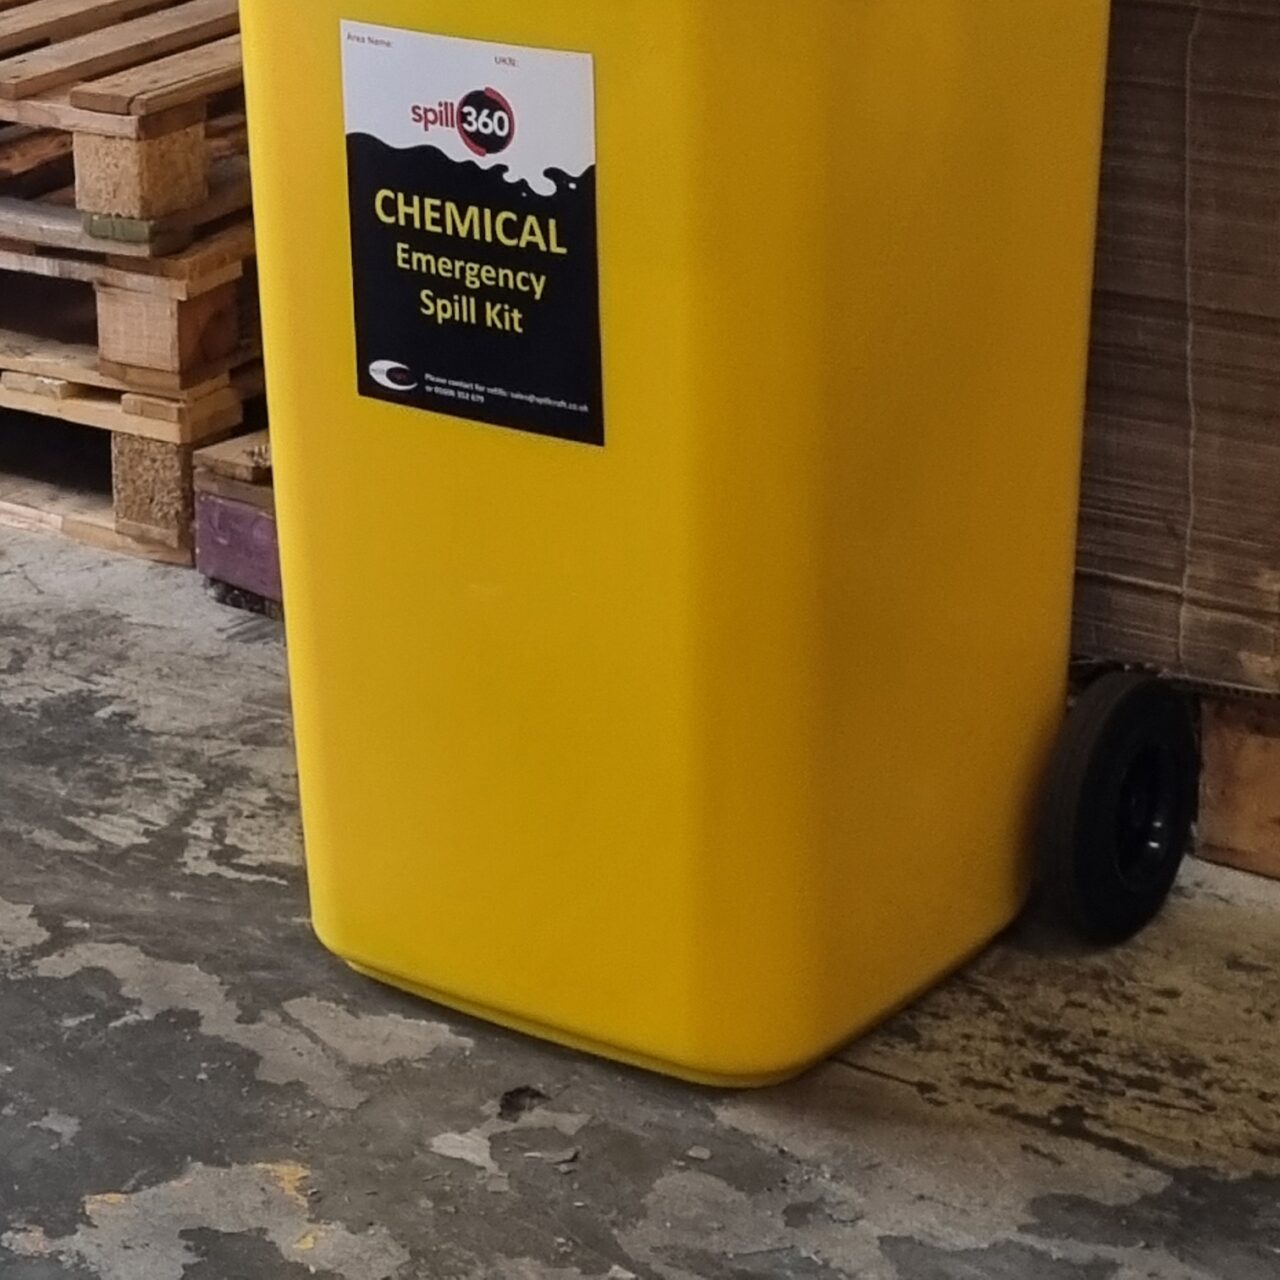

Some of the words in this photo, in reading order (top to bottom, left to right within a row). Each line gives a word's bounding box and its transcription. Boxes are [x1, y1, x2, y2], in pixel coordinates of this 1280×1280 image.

[411, 100, 455, 132] spill
[461, 105, 509, 137] 360
[374, 188, 568, 255] CHEMICAL
[396, 241, 547, 301] Emergency
[420, 288, 477, 325] Spill
[485, 300, 524, 334] Kit
